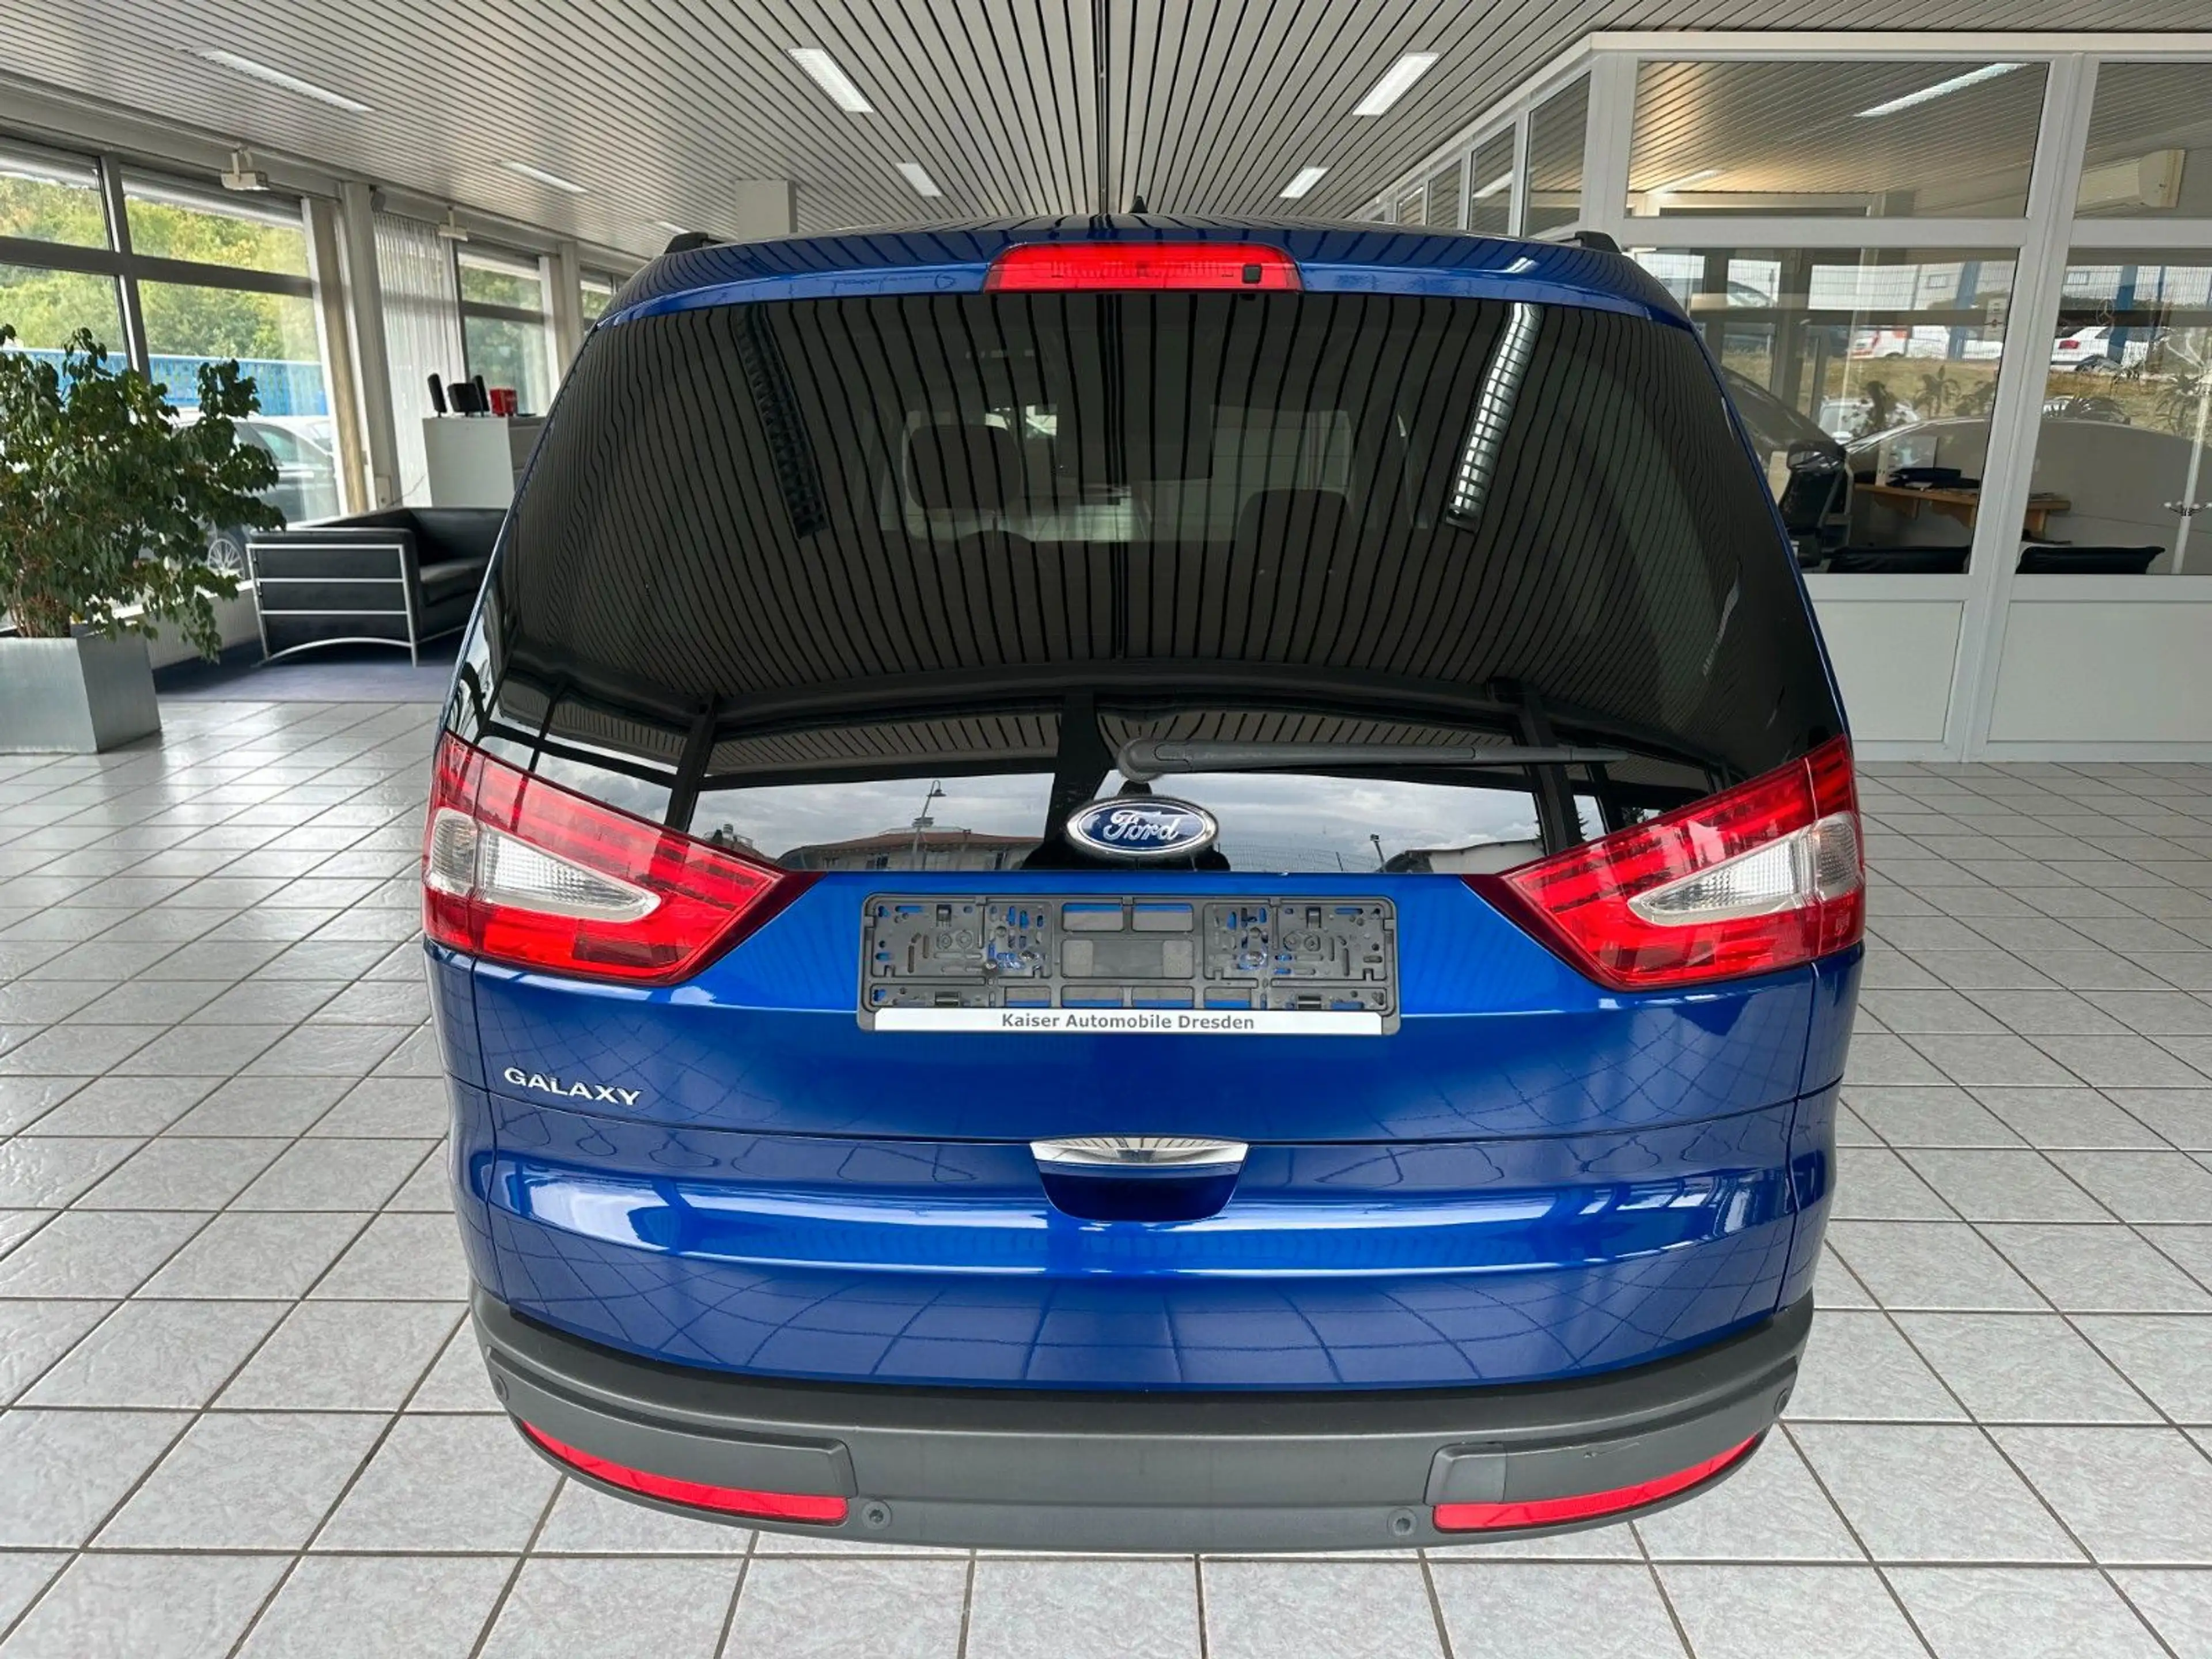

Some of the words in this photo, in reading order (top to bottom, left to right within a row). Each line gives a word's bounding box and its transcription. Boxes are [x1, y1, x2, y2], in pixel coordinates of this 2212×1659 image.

[1103, 809, 1181, 840] Ford
[1001, 1014, 1059, 1027] Kaiser
[1066, 1014, 1172, 1028] Automobile
[1178, 1015, 1255, 1029] Dresden
[503, 1067, 641, 1105] GALAXY
